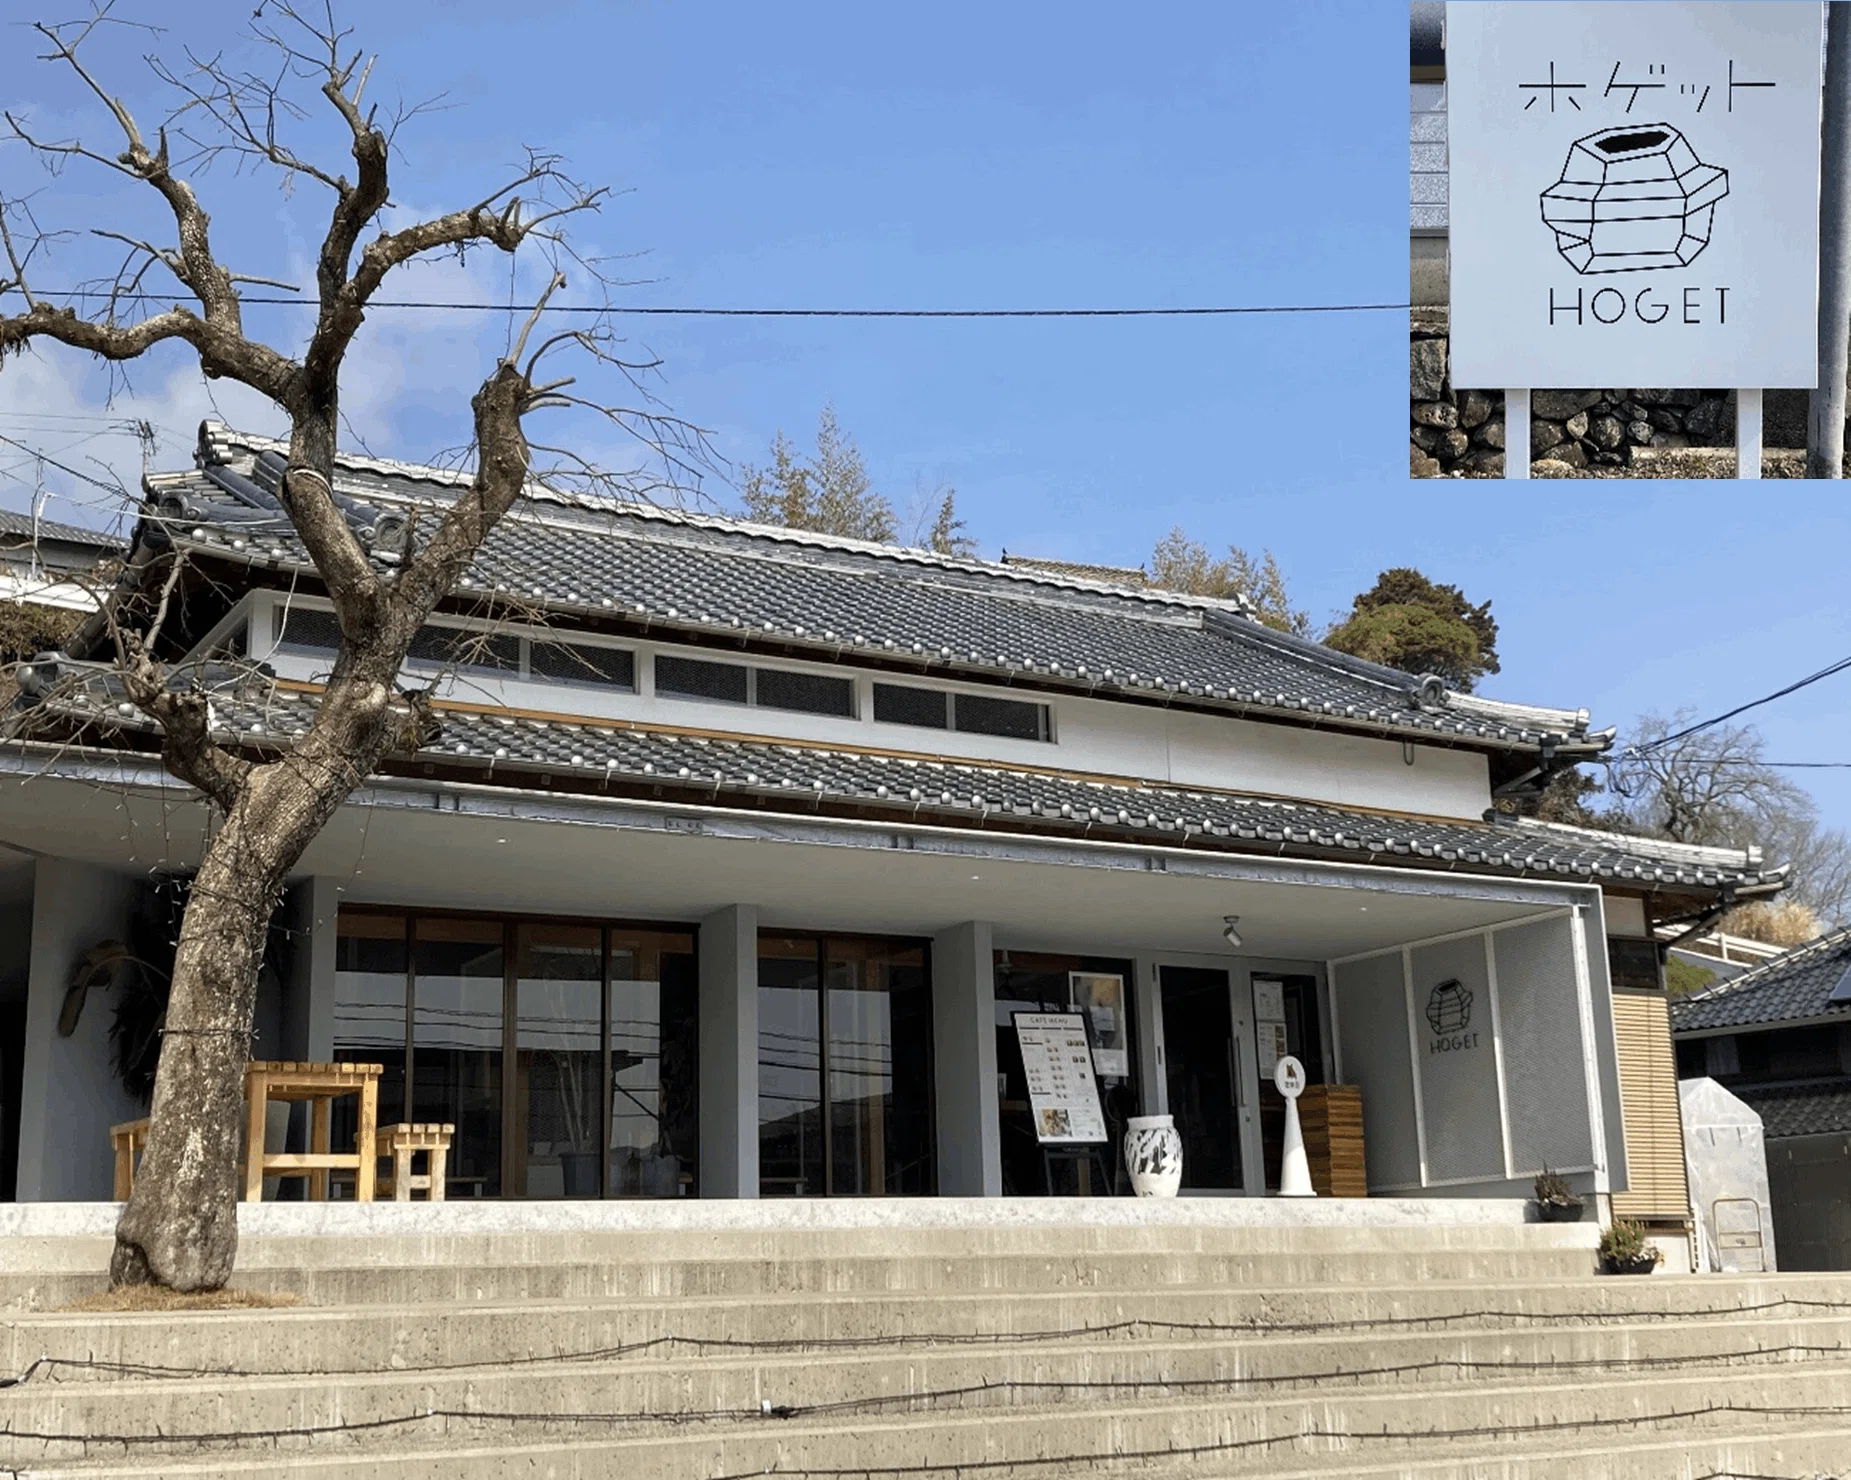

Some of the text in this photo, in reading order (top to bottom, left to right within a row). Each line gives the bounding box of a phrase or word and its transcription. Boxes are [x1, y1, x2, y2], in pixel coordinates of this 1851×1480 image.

[1518, 59, 1776, 113] ホゲット
[1549, 287, 1731, 325] HOGET
[1430, 1033, 1479, 1054] HOGET
